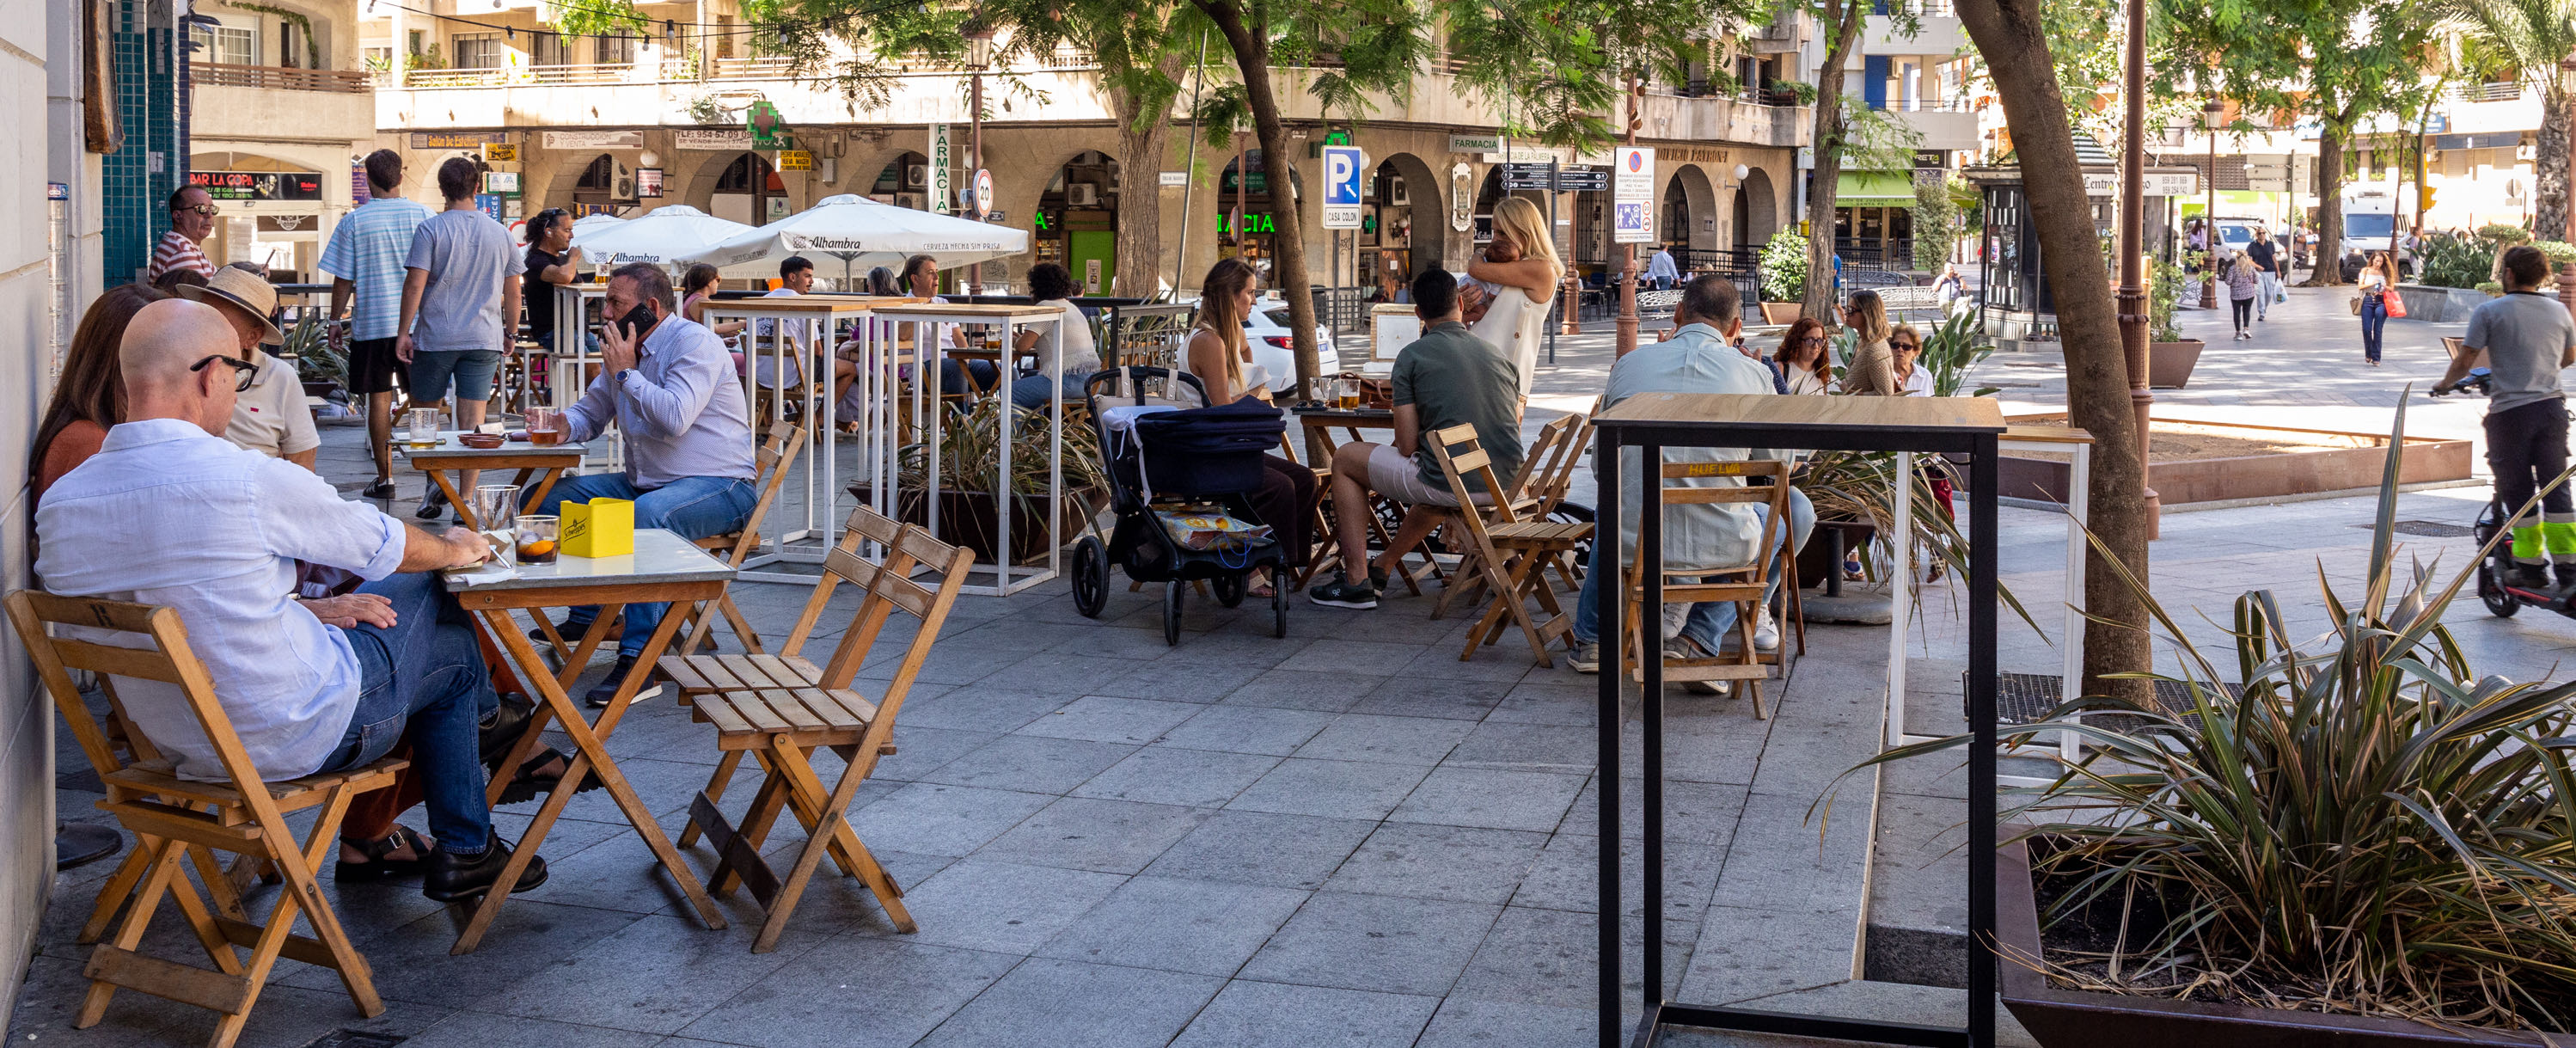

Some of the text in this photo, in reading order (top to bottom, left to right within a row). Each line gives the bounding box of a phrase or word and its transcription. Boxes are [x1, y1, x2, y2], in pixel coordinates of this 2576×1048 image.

[1454, 139, 1497, 149] FARMACIA
[936, 125, 948, 211] FARMACIA
[190, 173, 254, 187] BAR LA COPA
[1329, 153, 1354, 198] P
[980, 185, 989, 201] 20
[1328, 212, 1357, 222] CASA COLON
[809, 236, 860, 249] Alhambra
[1689, 463, 1741, 475] HUELVA
[564, 524, 585, 536] Schweppes
